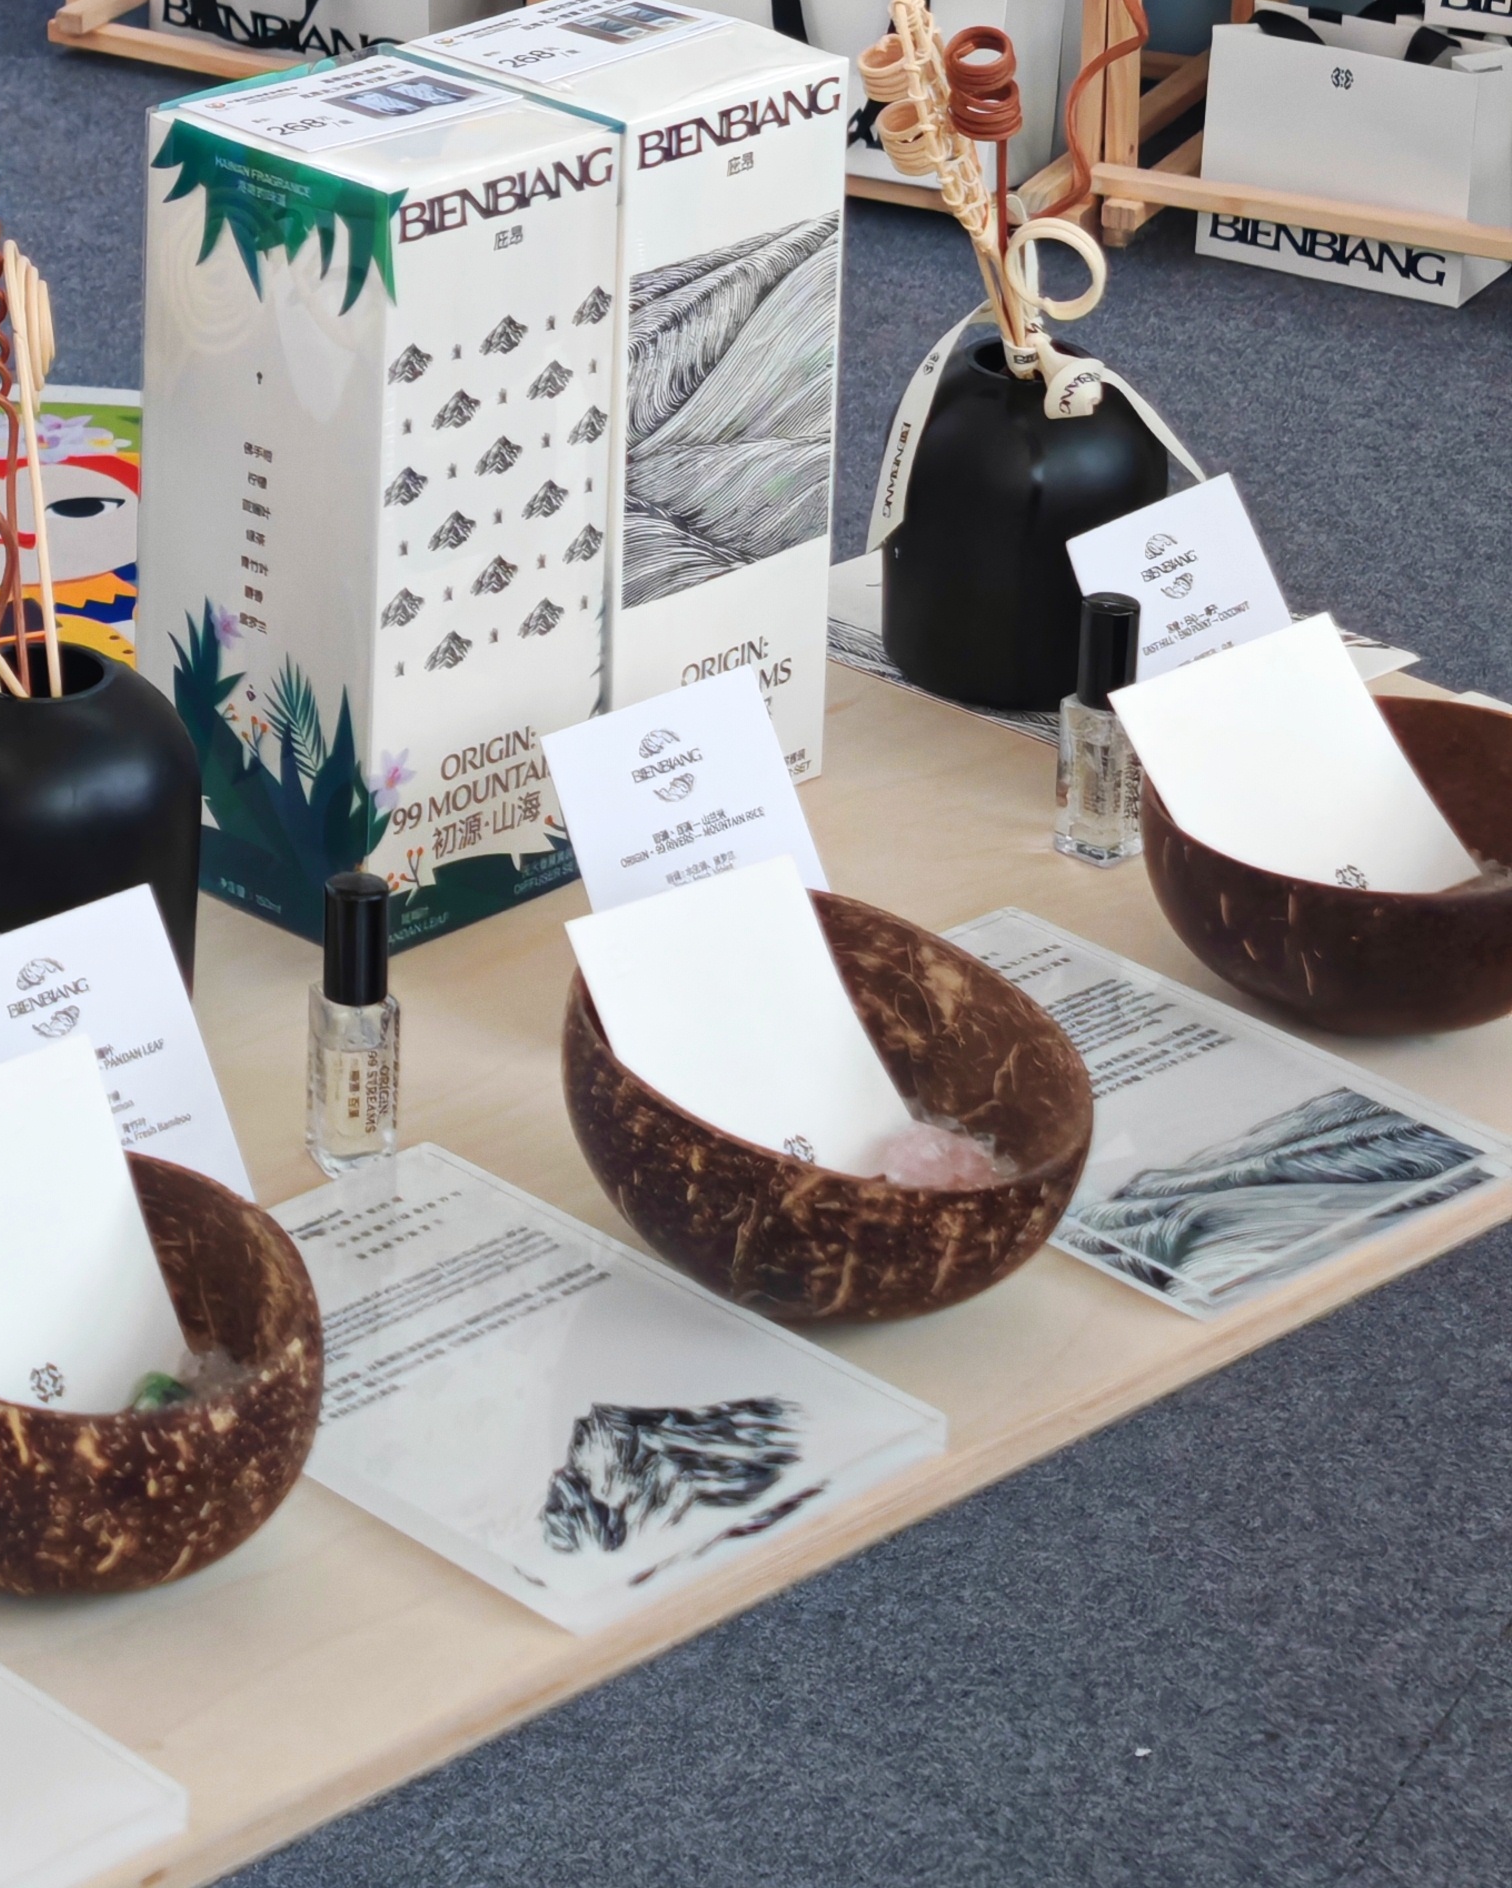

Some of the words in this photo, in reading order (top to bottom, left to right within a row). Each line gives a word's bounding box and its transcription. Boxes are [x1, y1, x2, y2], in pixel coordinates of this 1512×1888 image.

[498, 49, 556, 69] 268
[266, 116, 327, 137] 268
[637, 75, 841, 171] BIENBIANG
[398, 146, 613, 243] BIENBIANG
[1208, 212, 1447, 287] BIENBIANG
[680, 635, 770, 687] ORIGIN:
[758, 657, 792, 693] MS
[440, 725, 537, 782] ORIGIN:
[630, 747, 704, 784] BIENBIANG
[391, 801, 423, 836] 99
[6, 976, 91, 1020] BIENBIANG
[102, 1049, 142, 1071] PANDAN
[143, 1038, 166, 1057] LEAF
[364, 1069, 378, 1134] STREAMS
